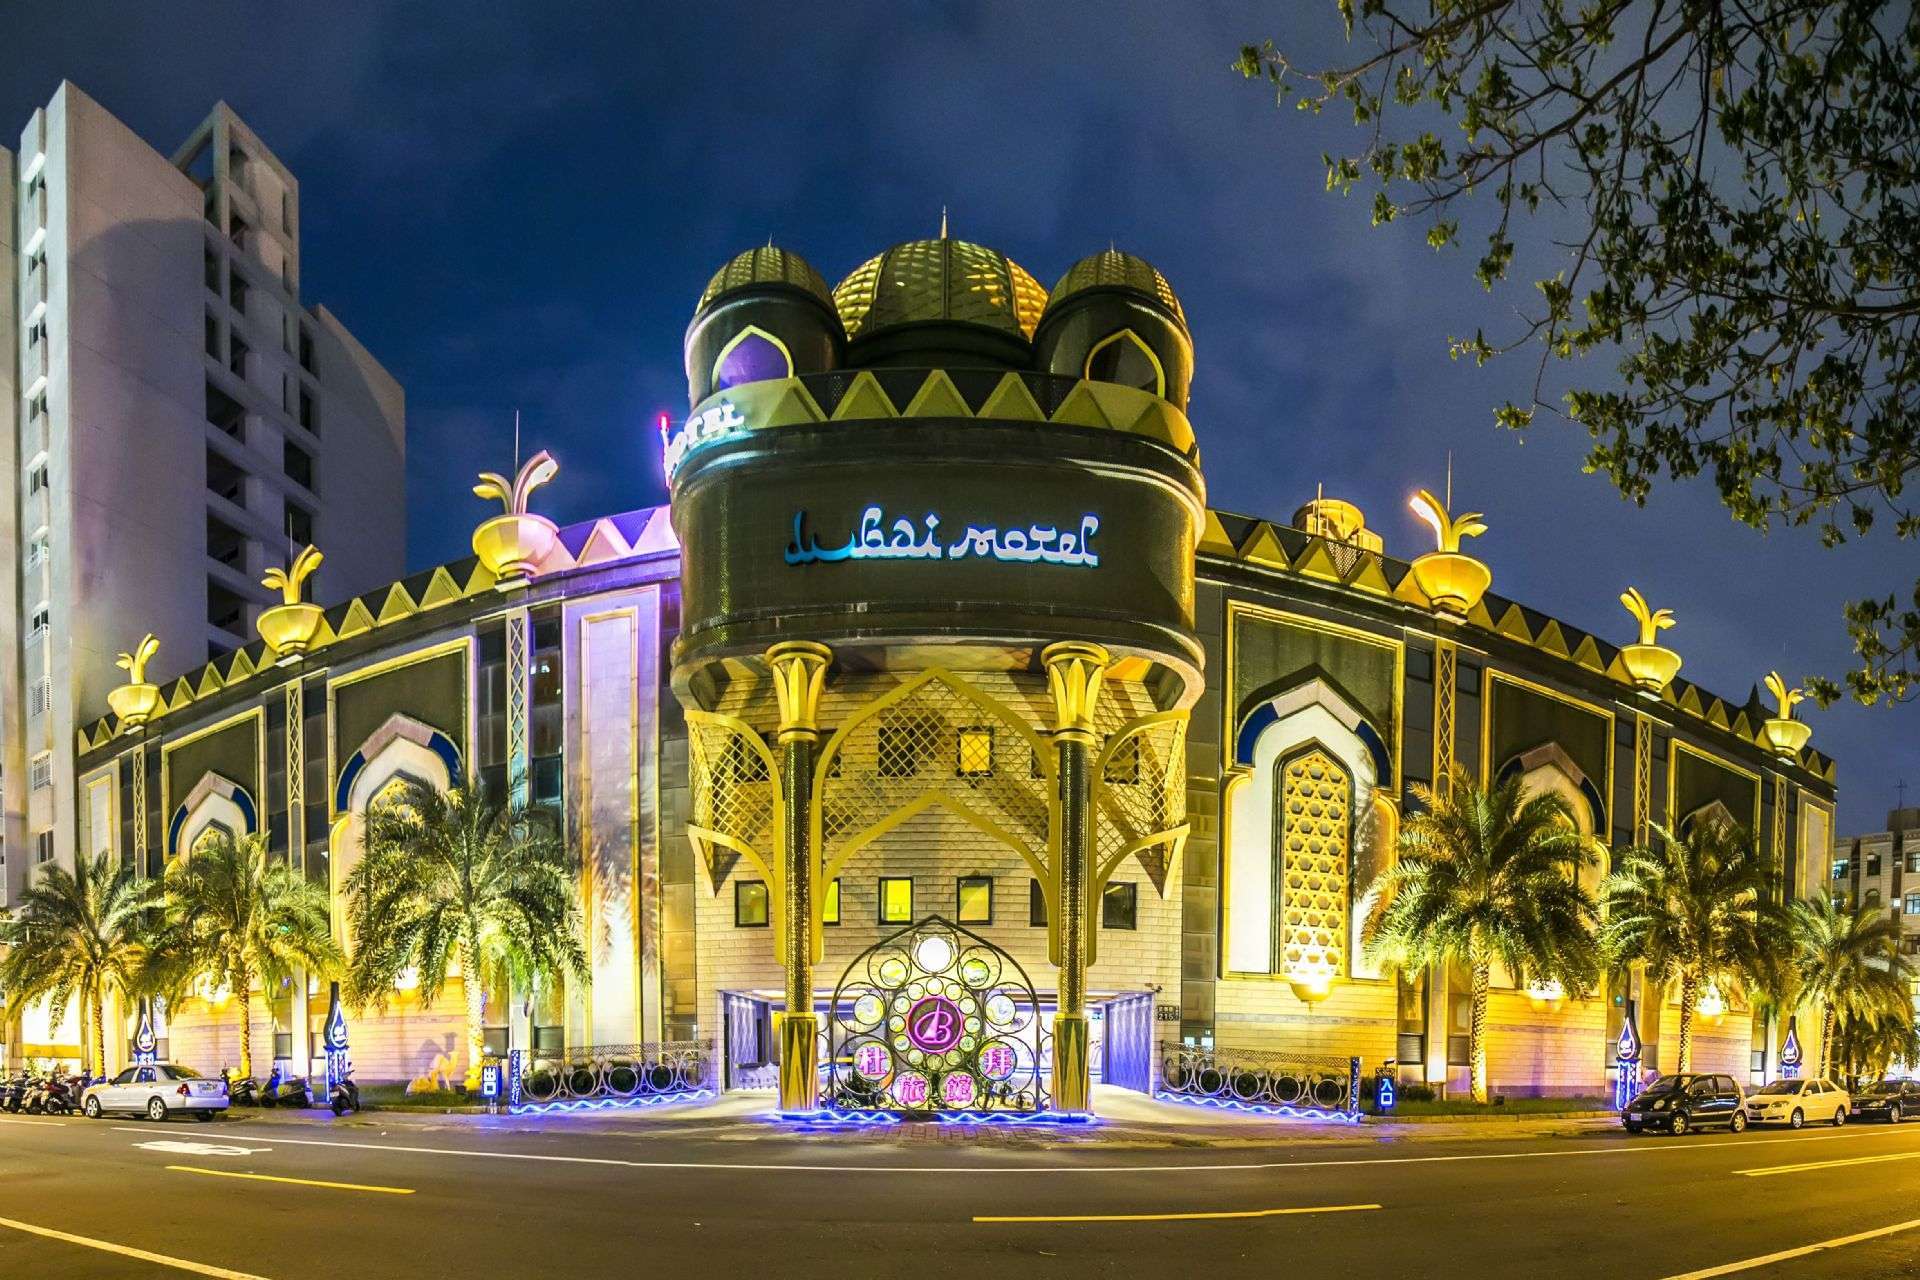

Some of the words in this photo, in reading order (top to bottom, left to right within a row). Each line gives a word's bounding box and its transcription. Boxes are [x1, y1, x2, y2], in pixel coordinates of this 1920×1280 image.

[784, 507, 941, 565] dubai
[858, 1047, 888, 1075] 杜
[984, 1047, 1013, 1076] 拜
[900, 1074, 928, 1103] 旅
[1380, 1078, 1394, 1105] 入口
